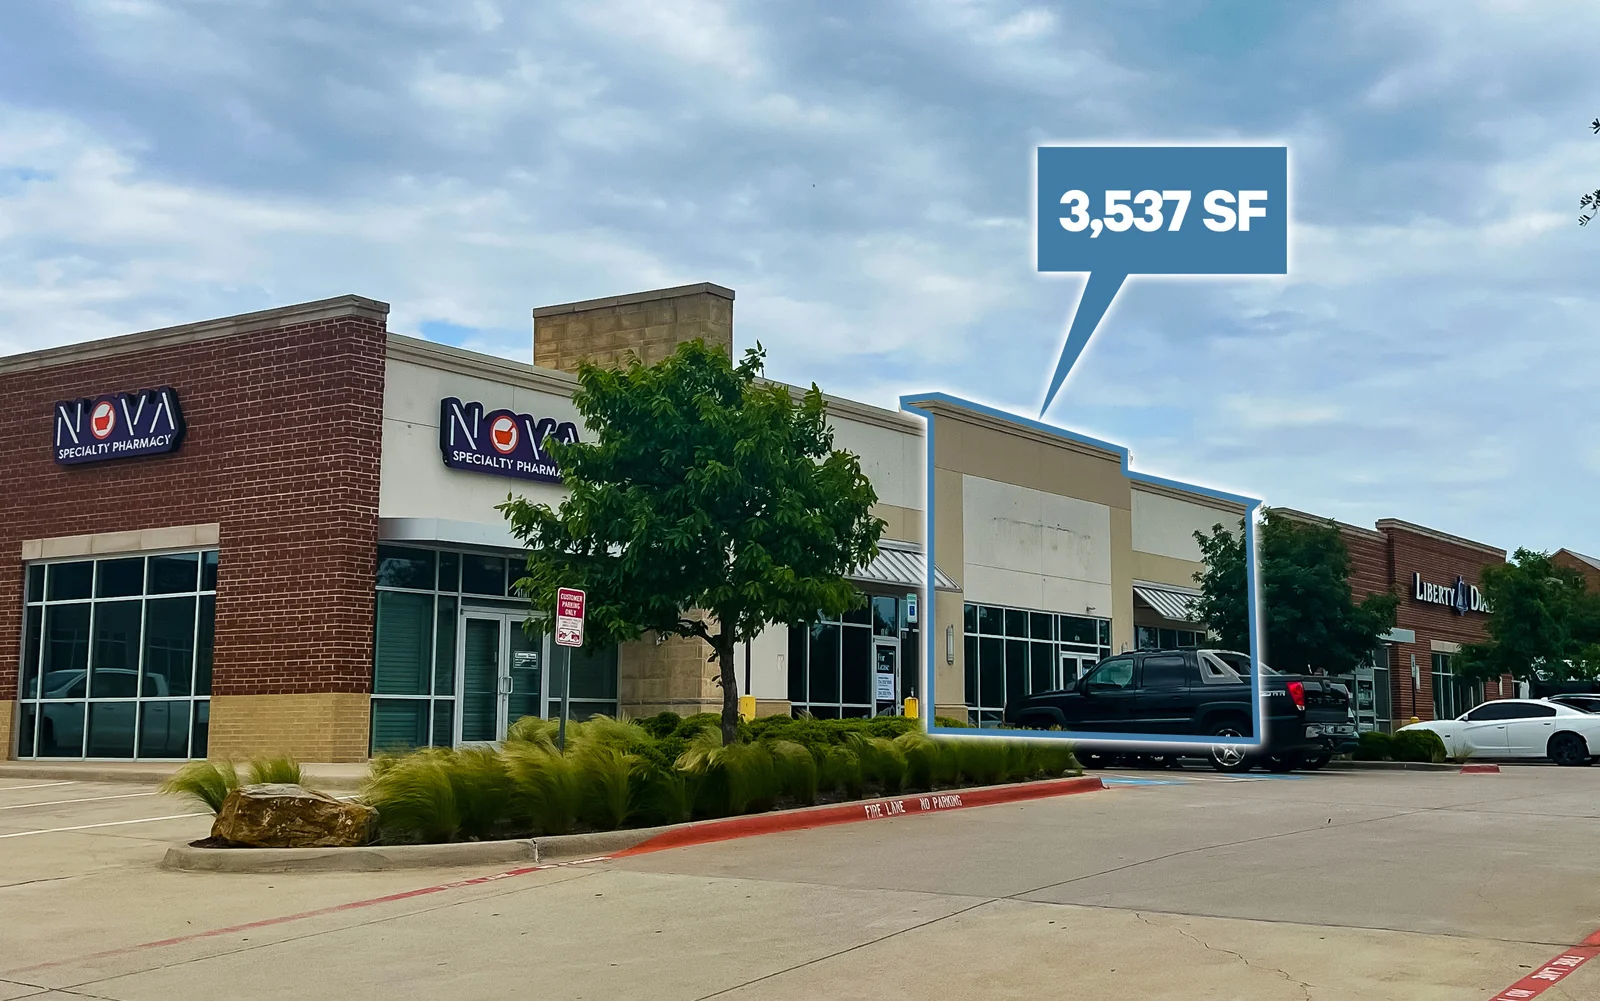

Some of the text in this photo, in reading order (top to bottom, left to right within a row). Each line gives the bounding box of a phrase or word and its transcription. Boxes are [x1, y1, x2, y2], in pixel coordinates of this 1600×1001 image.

[56, 392, 175, 447] NOVA
[58, 433, 172, 459] SPECIALTY PHARMACY
[452, 450, 564, 478] SPECIALTY PHARMA
[560, 593, 583, 602] CUSTOMER
[1414, 572, 1455, 607] LIBERTY
[561, 601, 581, 609] PARKING
[564, 608, 577, 616] ONLY
[864, 794, 963, 819] FIRE LANE NO PARKING
